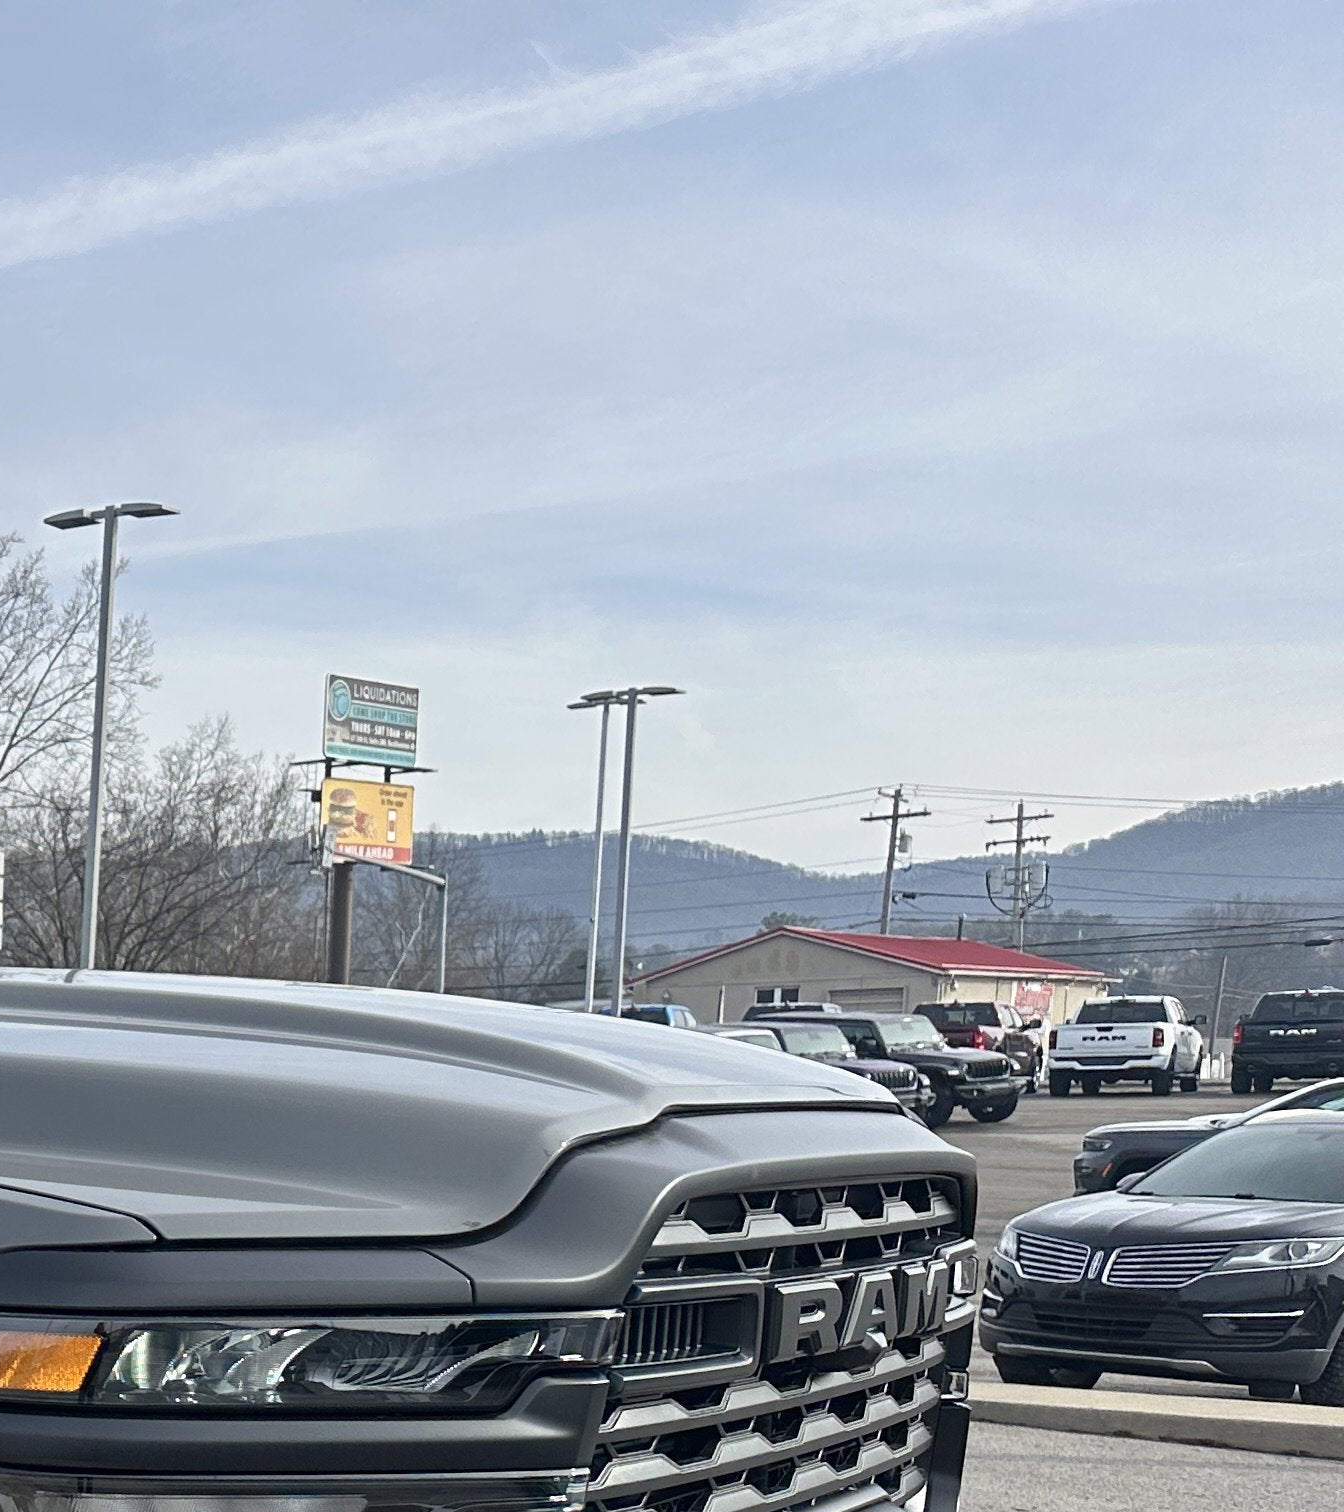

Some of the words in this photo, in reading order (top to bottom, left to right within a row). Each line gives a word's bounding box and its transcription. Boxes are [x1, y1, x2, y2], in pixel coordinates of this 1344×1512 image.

[353, 683, 417, 707] LIQUIDATIONS
[365, 846, 394, 860] AHEAD
[1081, 1034, 1127, 1042] RAM
[1269, 1028, 1319, 1036] RAM
[769, 1258, 949, 1364] RAM
